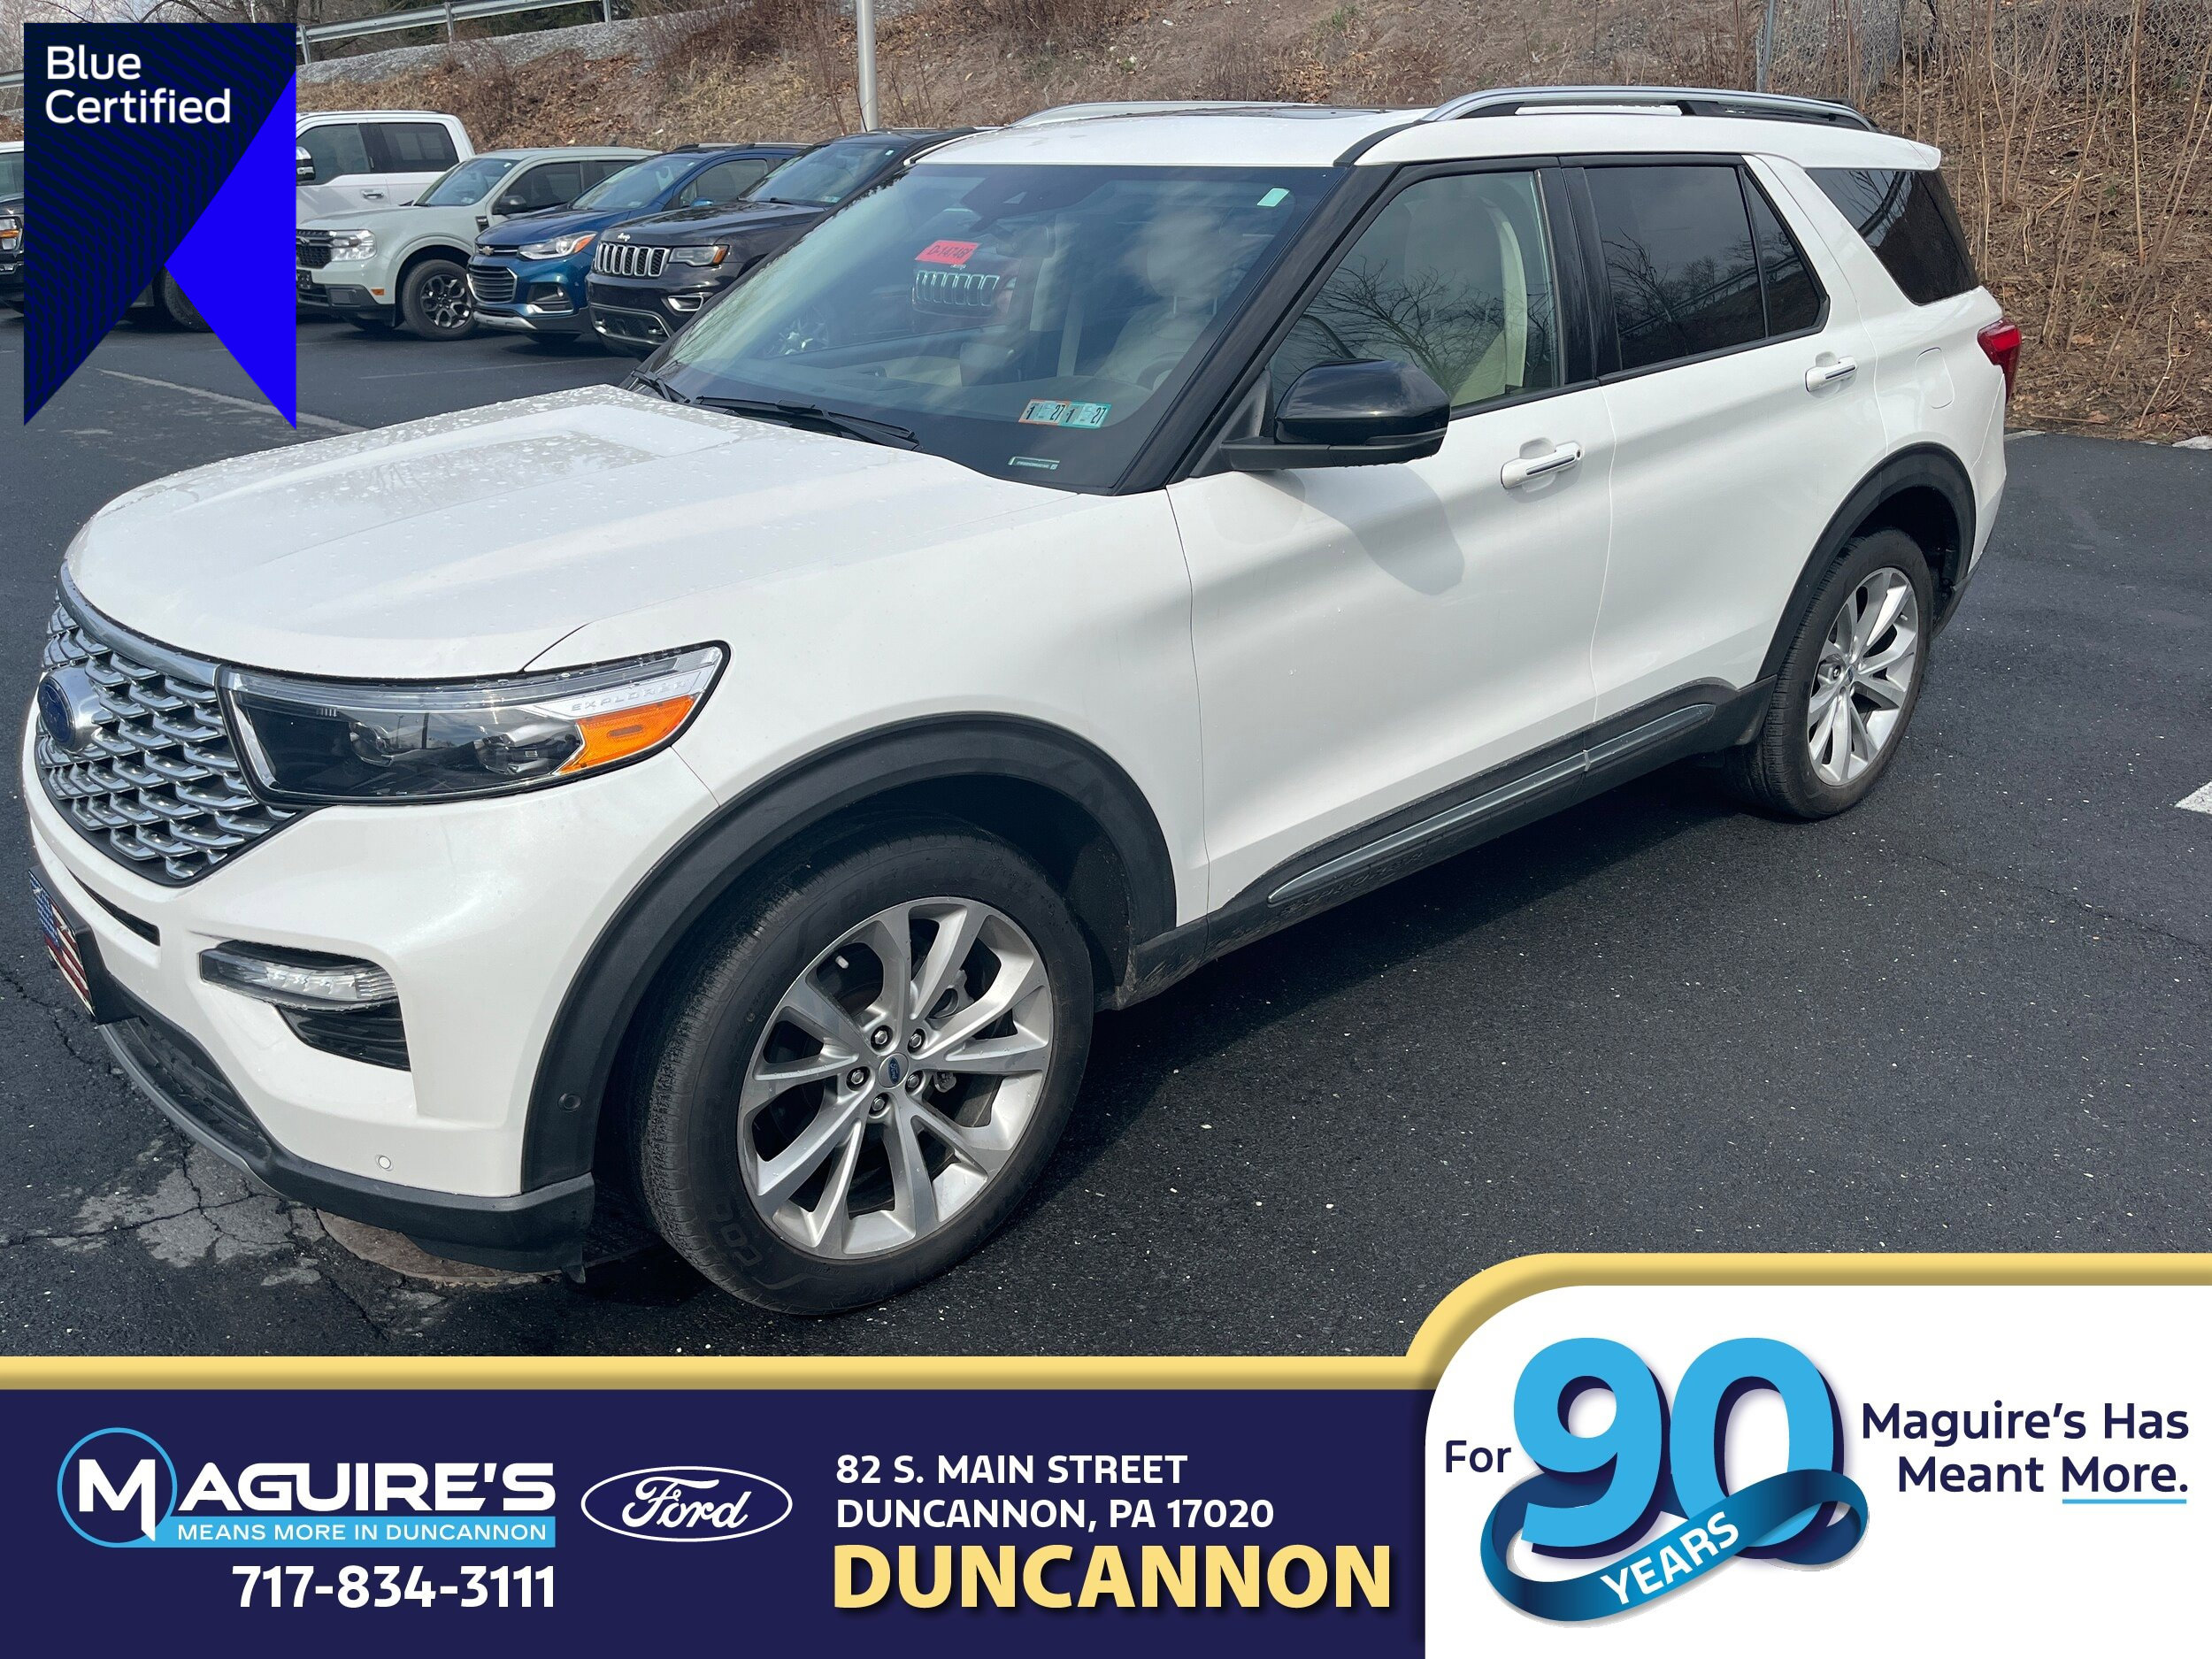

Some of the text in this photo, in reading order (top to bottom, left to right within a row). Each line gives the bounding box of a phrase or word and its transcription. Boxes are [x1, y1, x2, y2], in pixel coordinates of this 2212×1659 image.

[1049, 404, 1065, 421] 27
[1091, 407, 1107, 425] 27
[571, 680, 687, 711] EXPLORER
